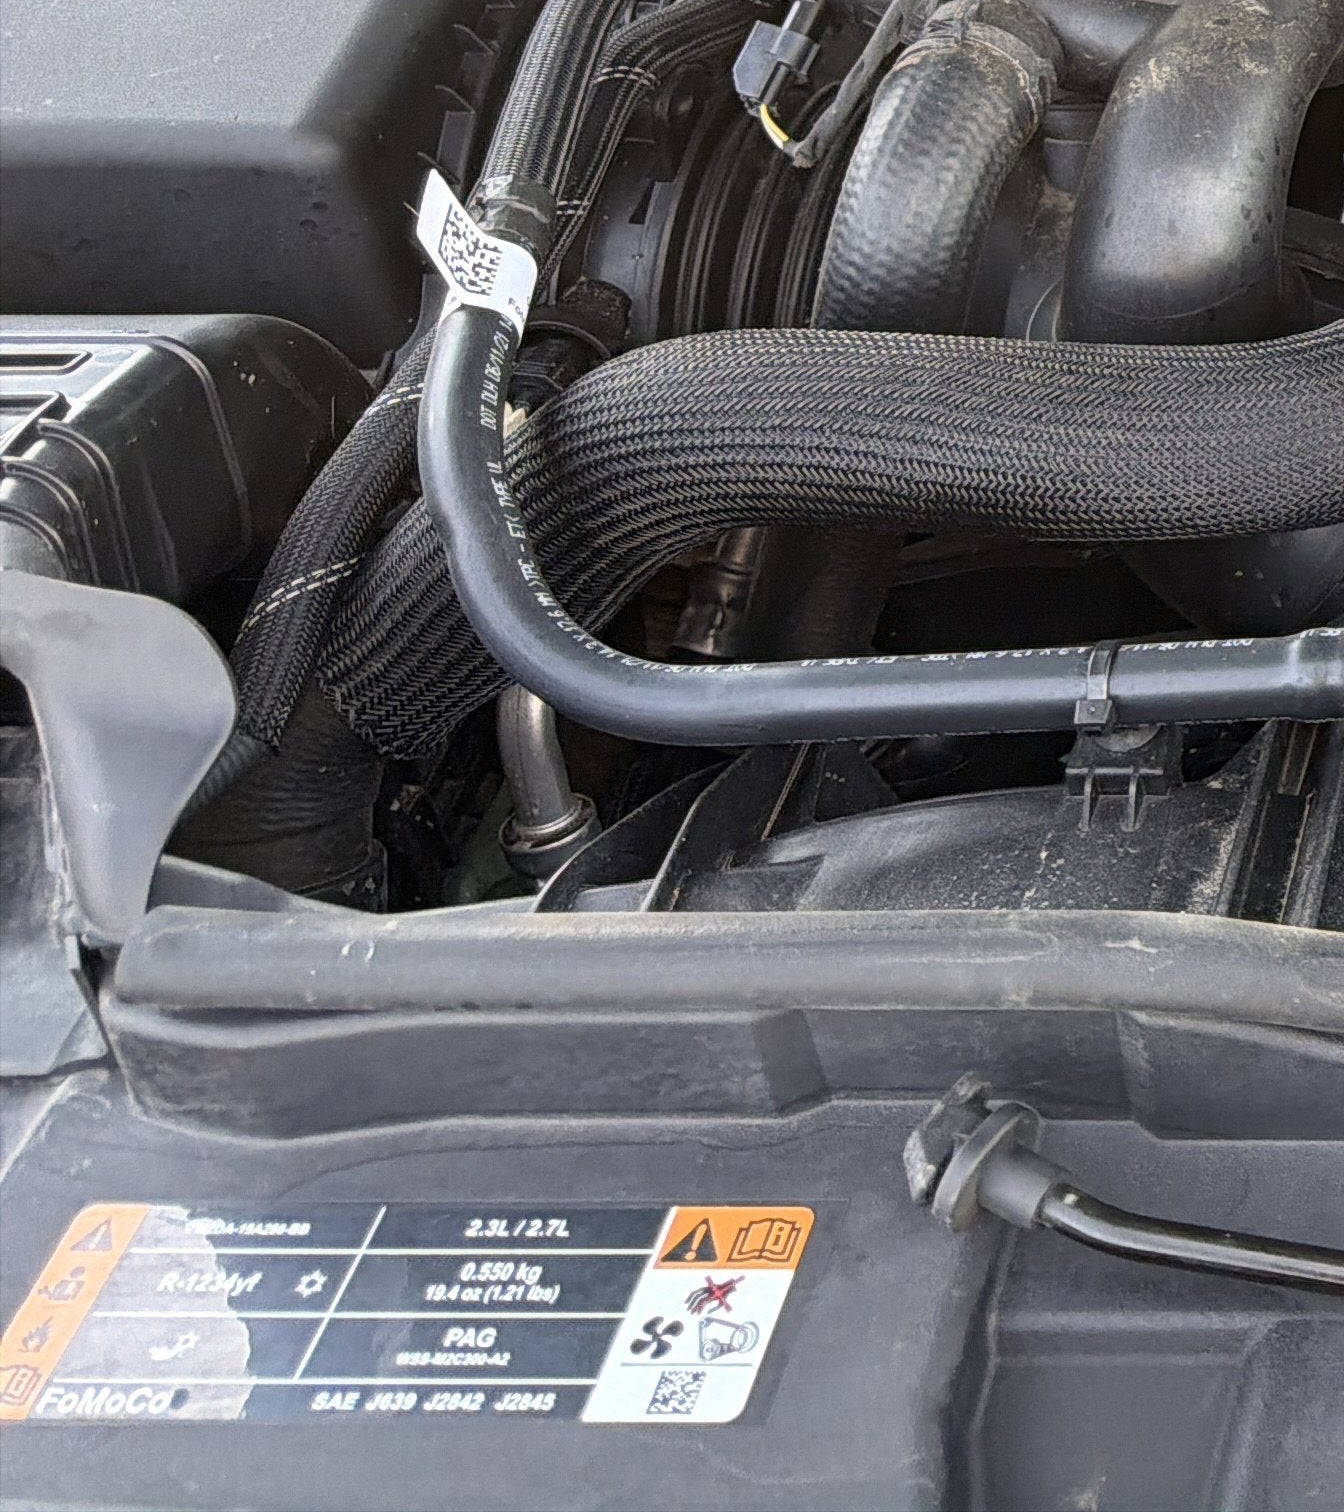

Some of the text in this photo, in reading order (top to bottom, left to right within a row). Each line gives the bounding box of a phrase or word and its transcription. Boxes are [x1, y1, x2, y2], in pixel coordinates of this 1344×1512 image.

[480, 404, 497, 430] DOT
[464, 1218, 510, 1238] 2.3L
[525, 1218, 570, 1238] 2.7L
[157, 1270, 259, 1298] R-1234yf
[460, 1261, 544, 1285] 0.550 kg
[425, 1284, 561, 1305] 19.4 oz (1.21 lbs)
[442, 1327, 498, 1348] PAG
[36, 1388, 557, 1416] FoMoCo SAE J639 J2842 J2845
